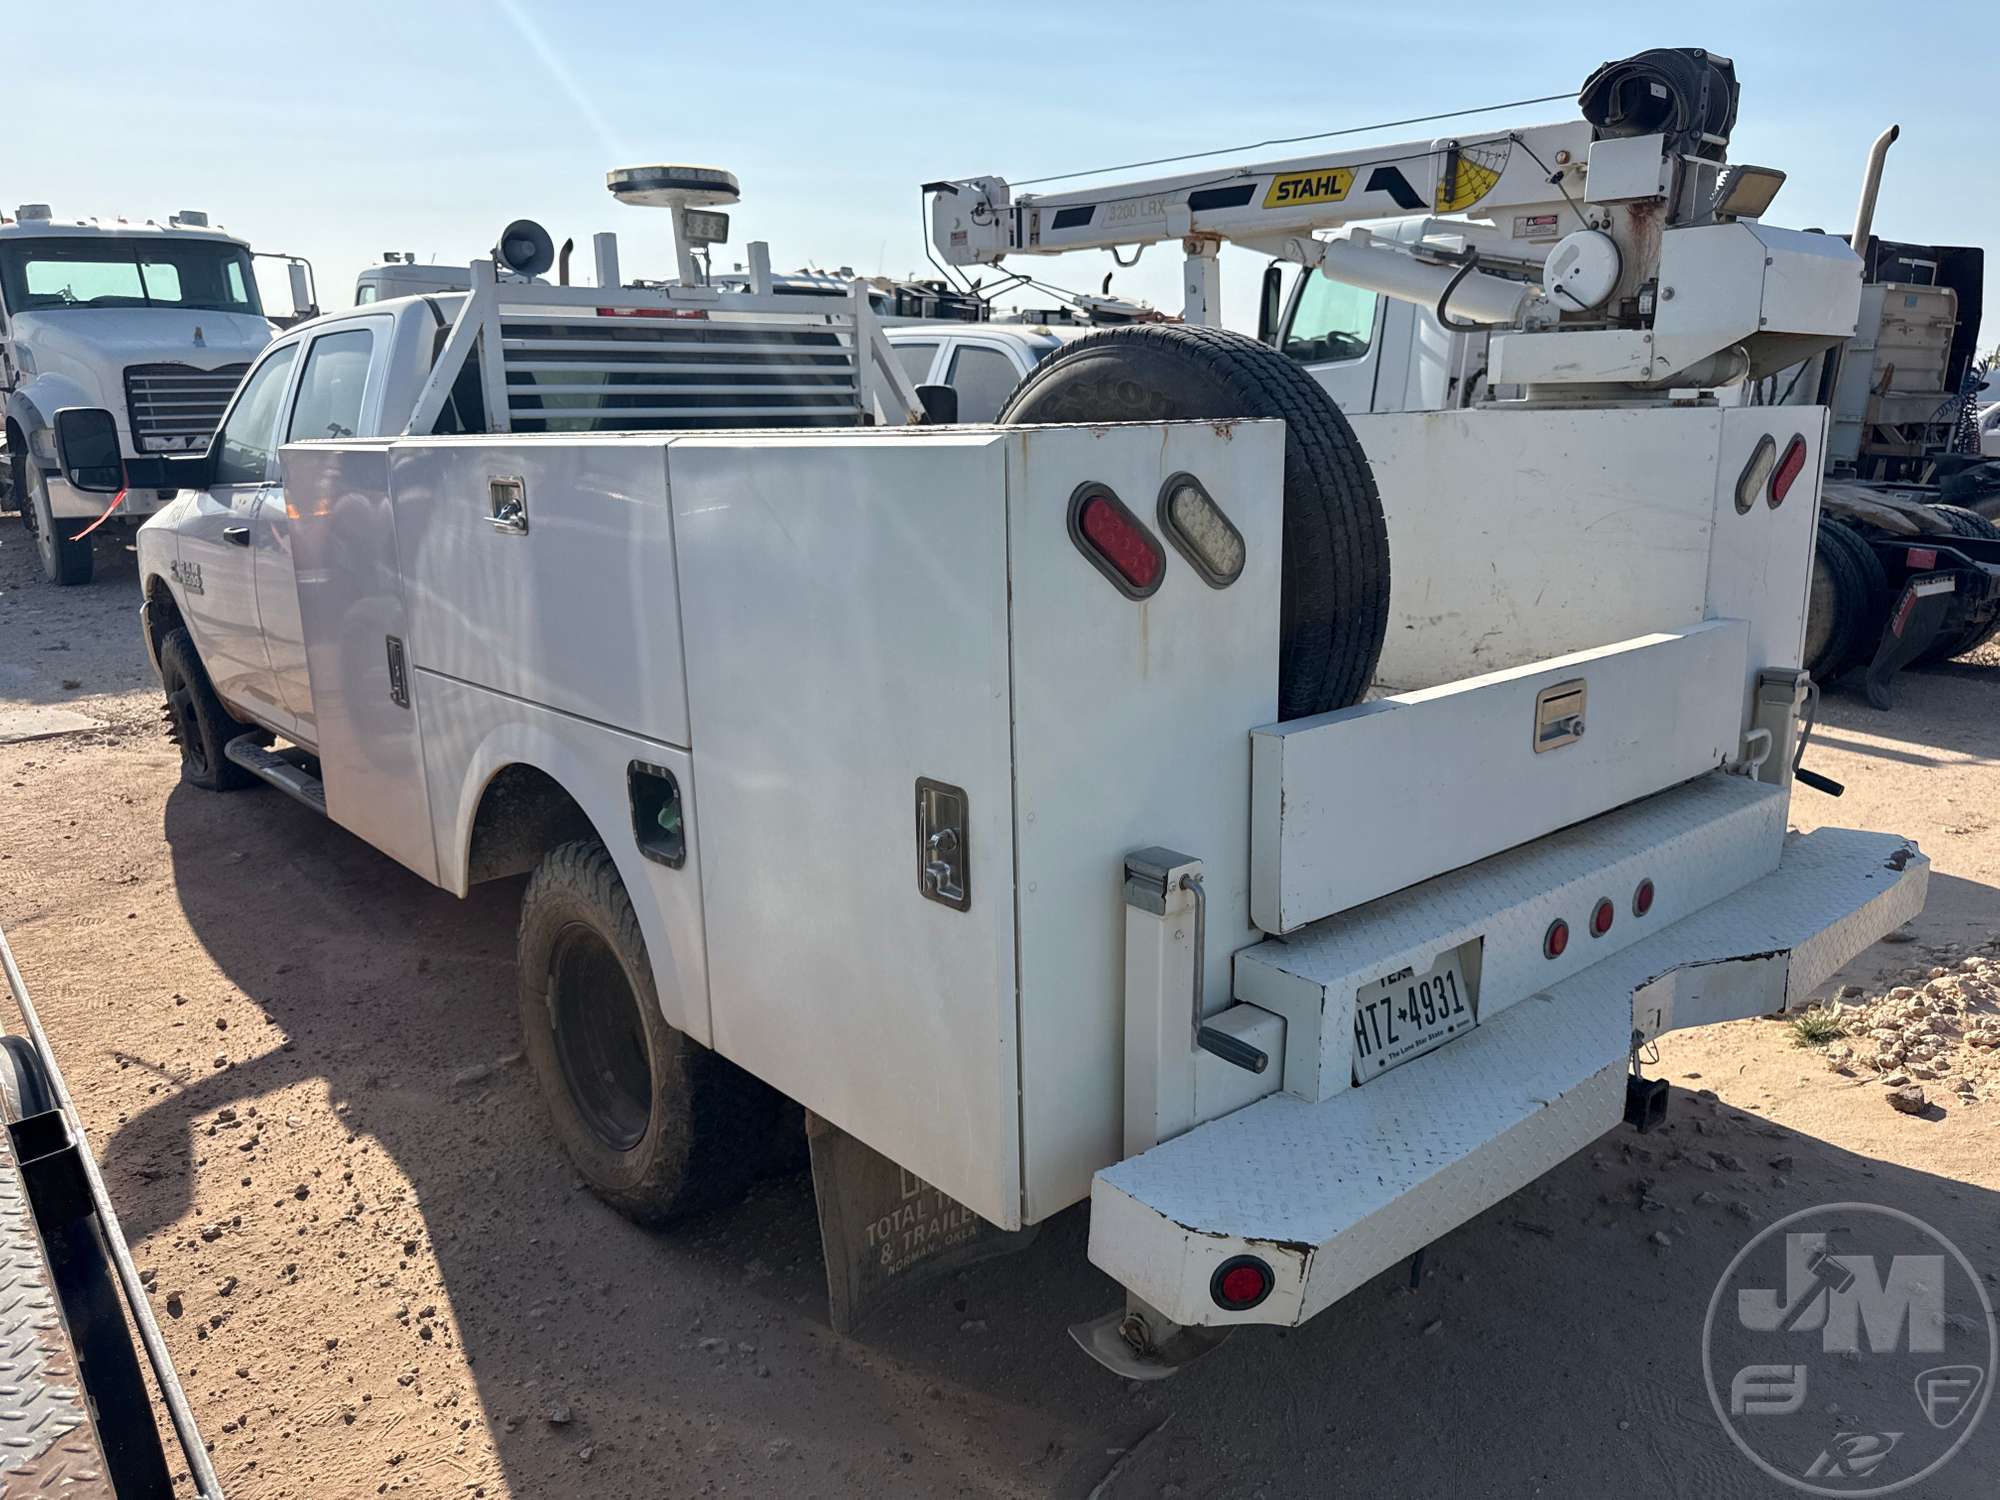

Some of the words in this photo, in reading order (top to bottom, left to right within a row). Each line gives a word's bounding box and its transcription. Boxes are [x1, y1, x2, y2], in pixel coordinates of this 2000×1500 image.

[1276, 175, 1342, 201] STAHL
[1354, 996, 1400, 1058] HTZ
[1408, 969, 1465, 1031] 4931
[1428, 1029, 1445, 1041] State
[865, 1199, 928, 1247] TOTAL
[880, 1242, 894, 1265] &
[903, 1206, 979, 1251] TRAILE
